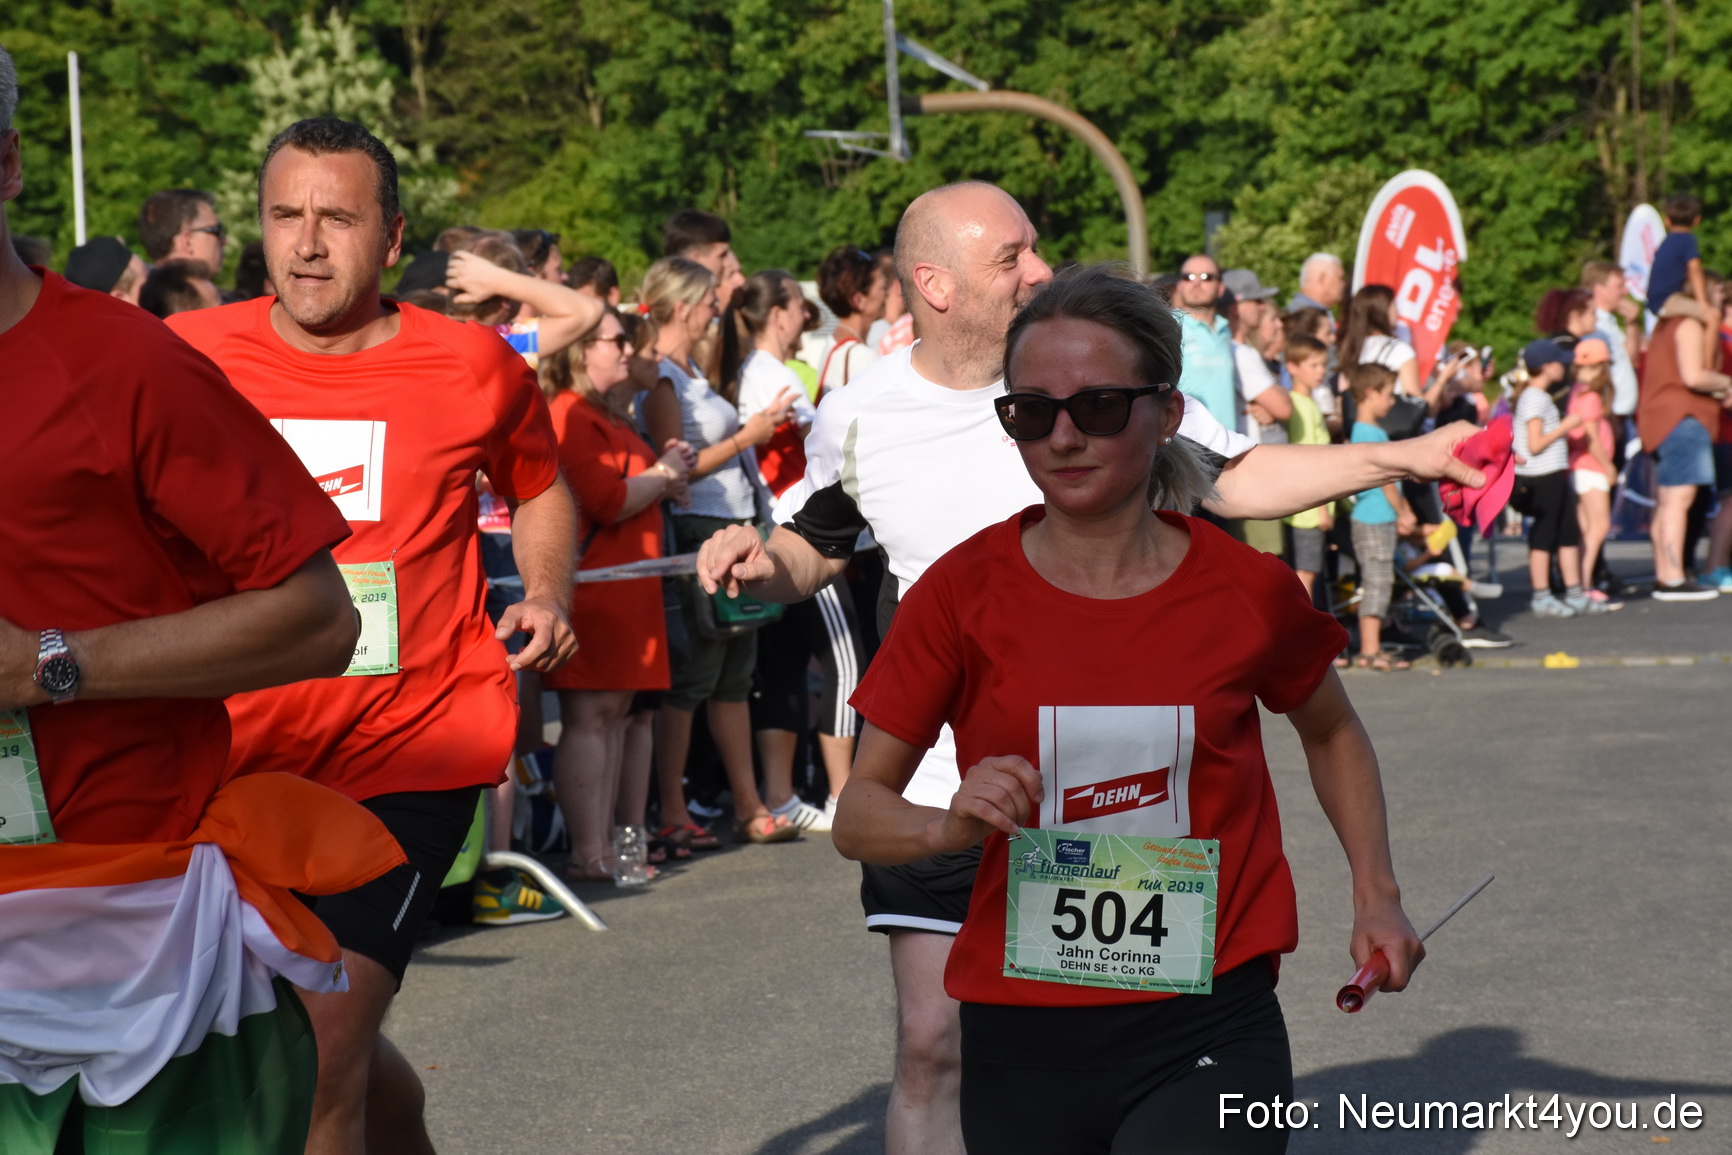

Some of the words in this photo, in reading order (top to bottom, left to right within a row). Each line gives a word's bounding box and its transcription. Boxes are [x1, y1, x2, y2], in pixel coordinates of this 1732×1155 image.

[318, 476, 343, 493] EHN
[361, 592, 387, 603] 2019
[354, 645, 368, 655] olf
[2, 745, 19, 758] 19
[1091, 783, 1142, 809] DEHN
[1062, 846, 1086, 854] Fischer
[1041, 860, 1121, 879] firmenlauf
[1167, 881, 1204, 893] 2019
[1051, 888, 1168, 947] 504
[1057, 944, 1094, 959] Jahn
[1099, 947, 1161, 964] Corinna
[1060, 960, 1091, 971] DEHN
[1094, 963, 1108, 973] SE
[1121, 965, 1135, 975] Co
[1139, 966, 1155, 976] KG
